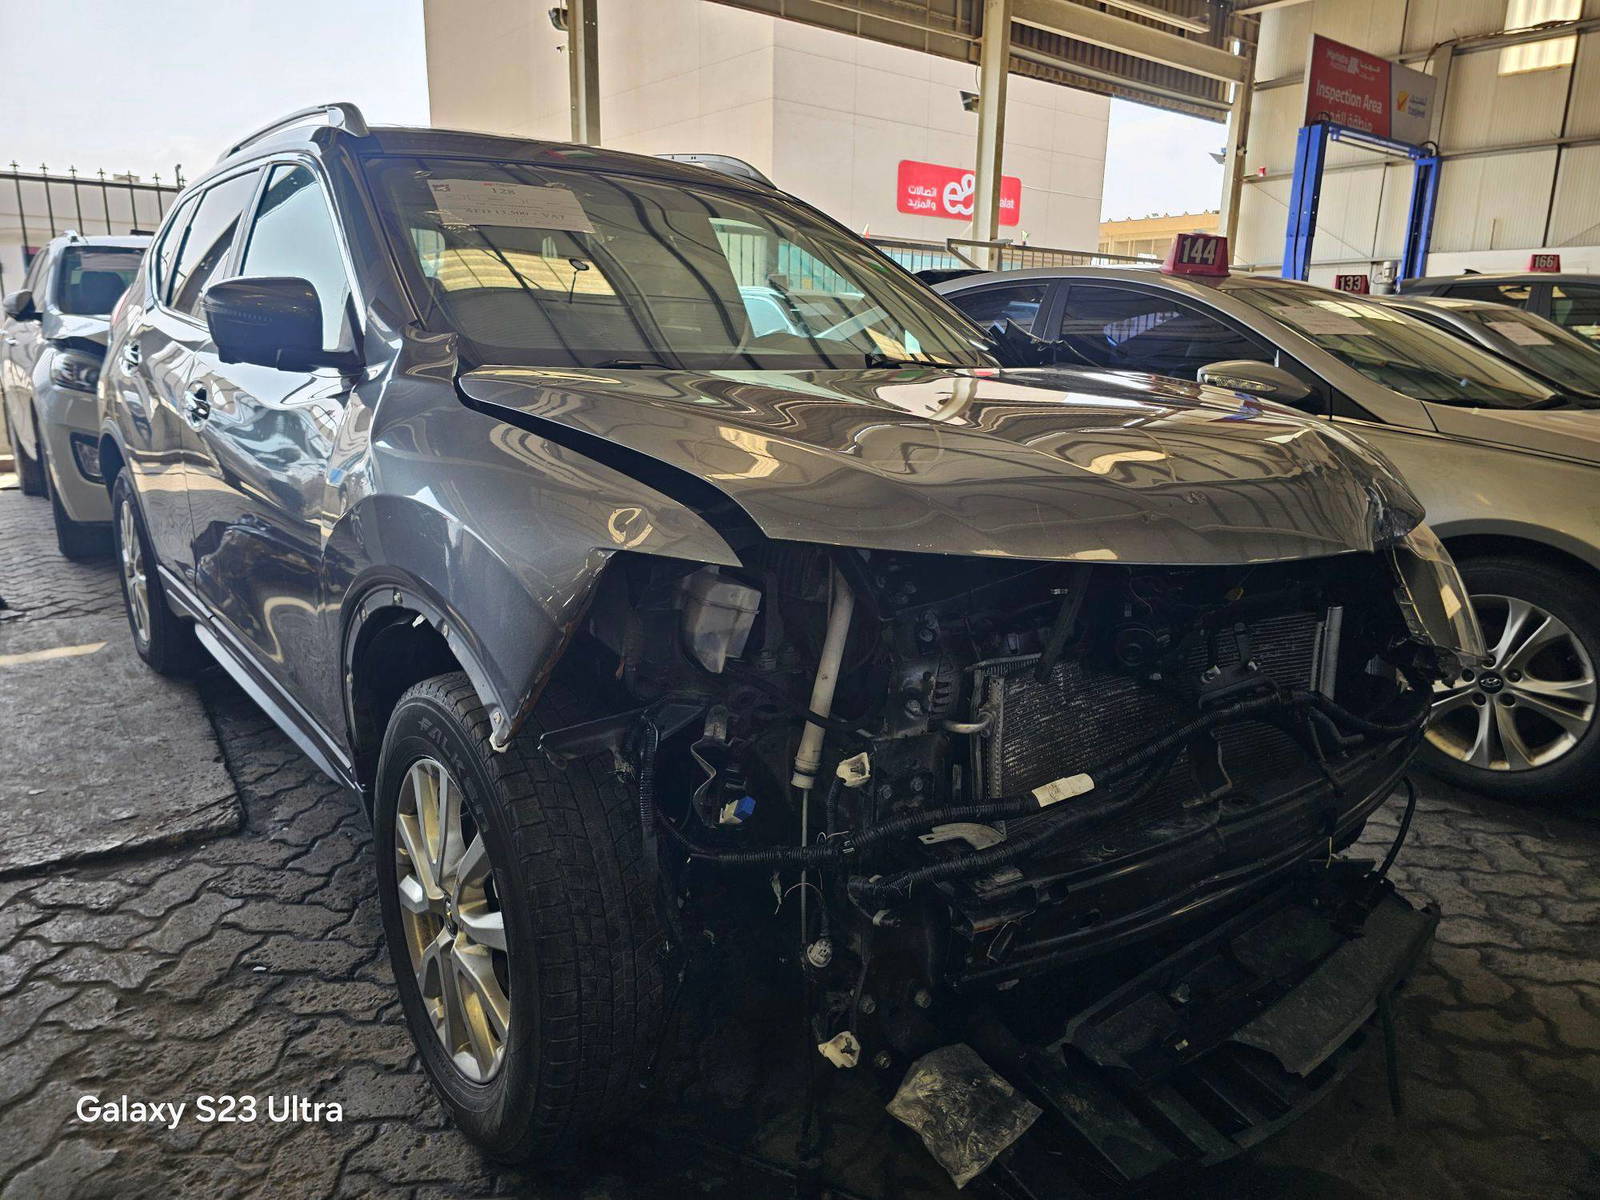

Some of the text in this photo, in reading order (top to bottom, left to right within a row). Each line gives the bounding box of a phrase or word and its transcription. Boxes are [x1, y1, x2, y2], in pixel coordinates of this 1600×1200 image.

[1316, 79, 1361, 108] Inspection
[1363, 95, 1383, 114] Area
[908, 185, 937, 198] اتصالات
[1182, 237, 1217, 264] 144
[1535, 255, 1554, 268] 166
[1340, 275, 1362, 291] 133
